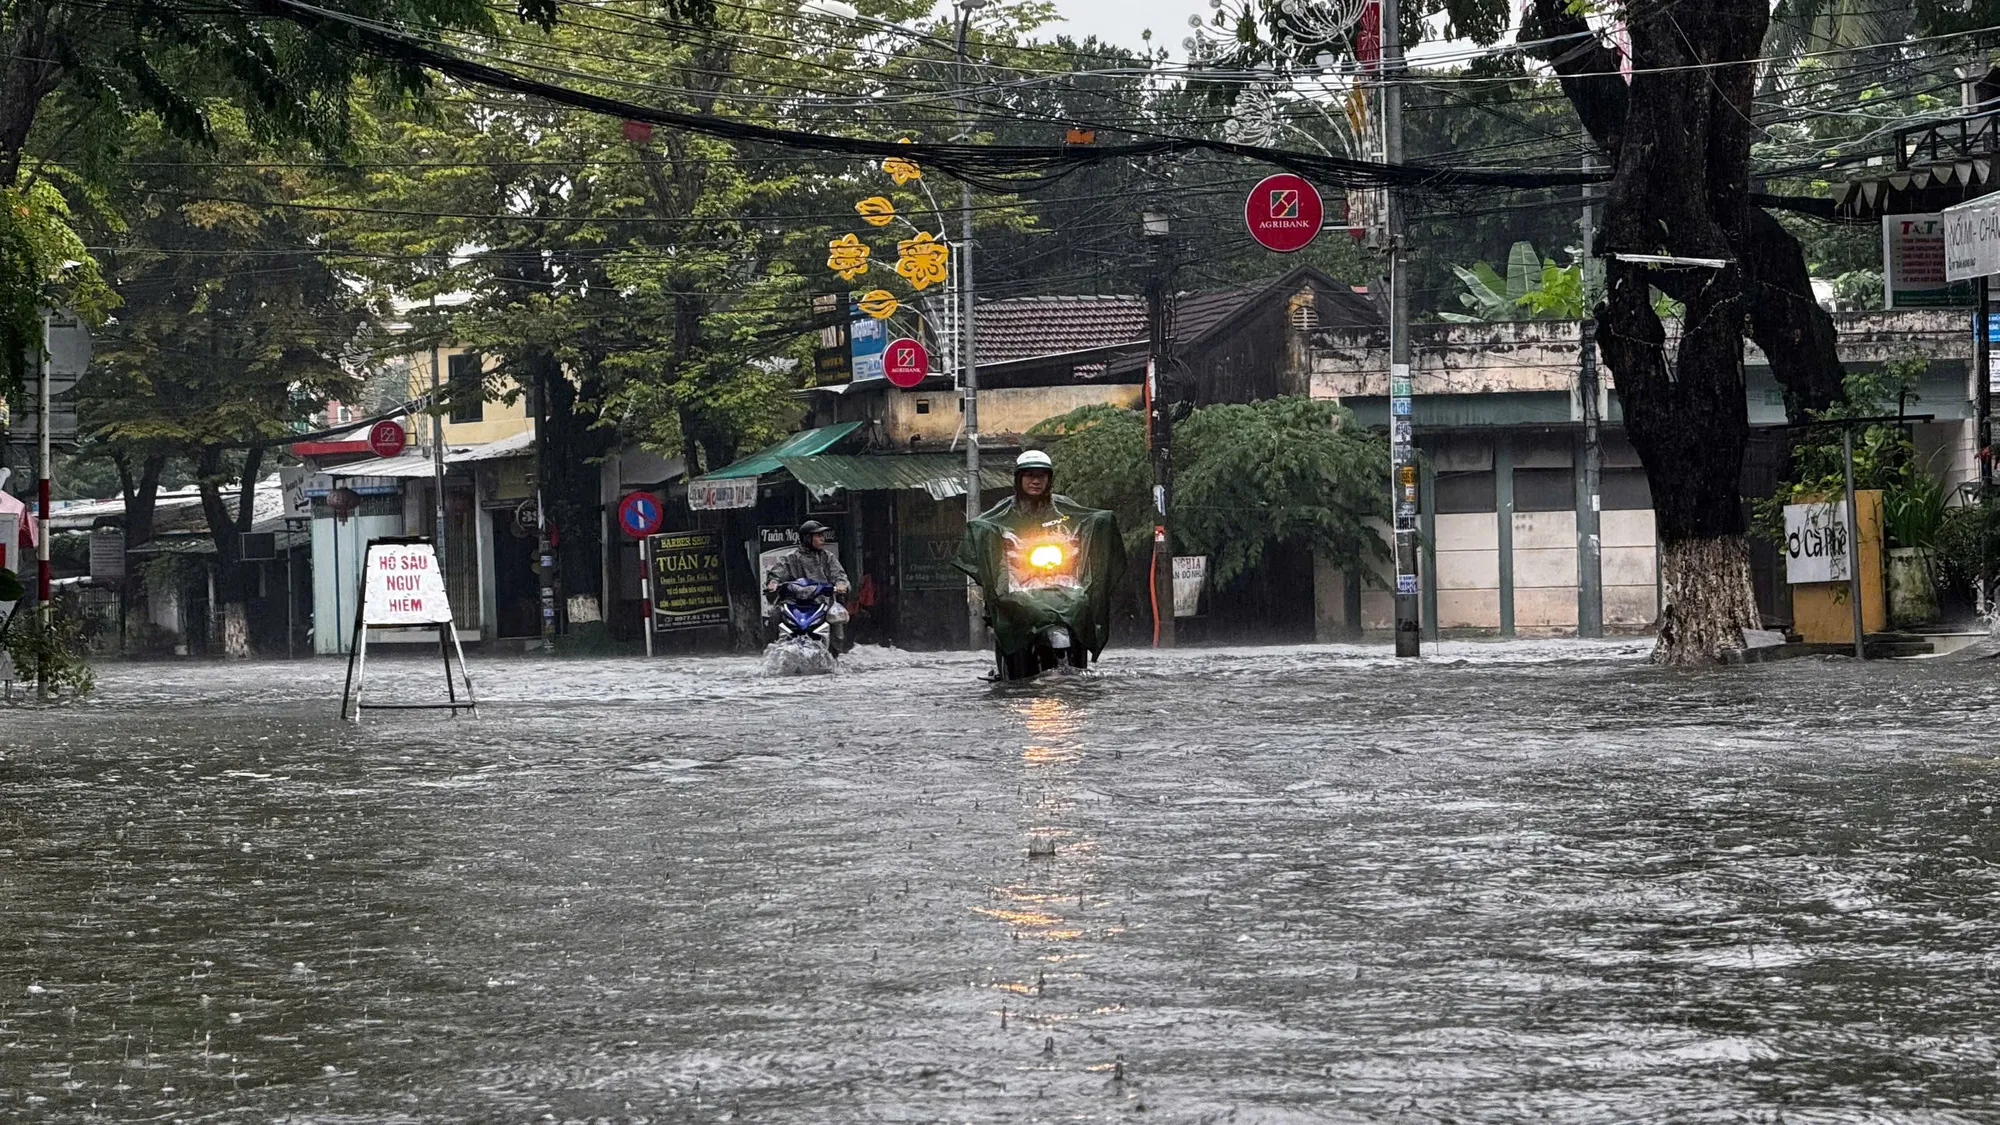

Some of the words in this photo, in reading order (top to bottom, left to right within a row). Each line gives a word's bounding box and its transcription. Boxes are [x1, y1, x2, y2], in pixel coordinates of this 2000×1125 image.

[1259, 220, 1310, 229] AGRIBANK
[661, 537, 691, 548] BARBER
[1804, 529, 1823, 557] Cà
[401, 552, 429, 570] SÂU
[703, 554, 719, 568] 76
[386, 574, 422, 591] NGUY
